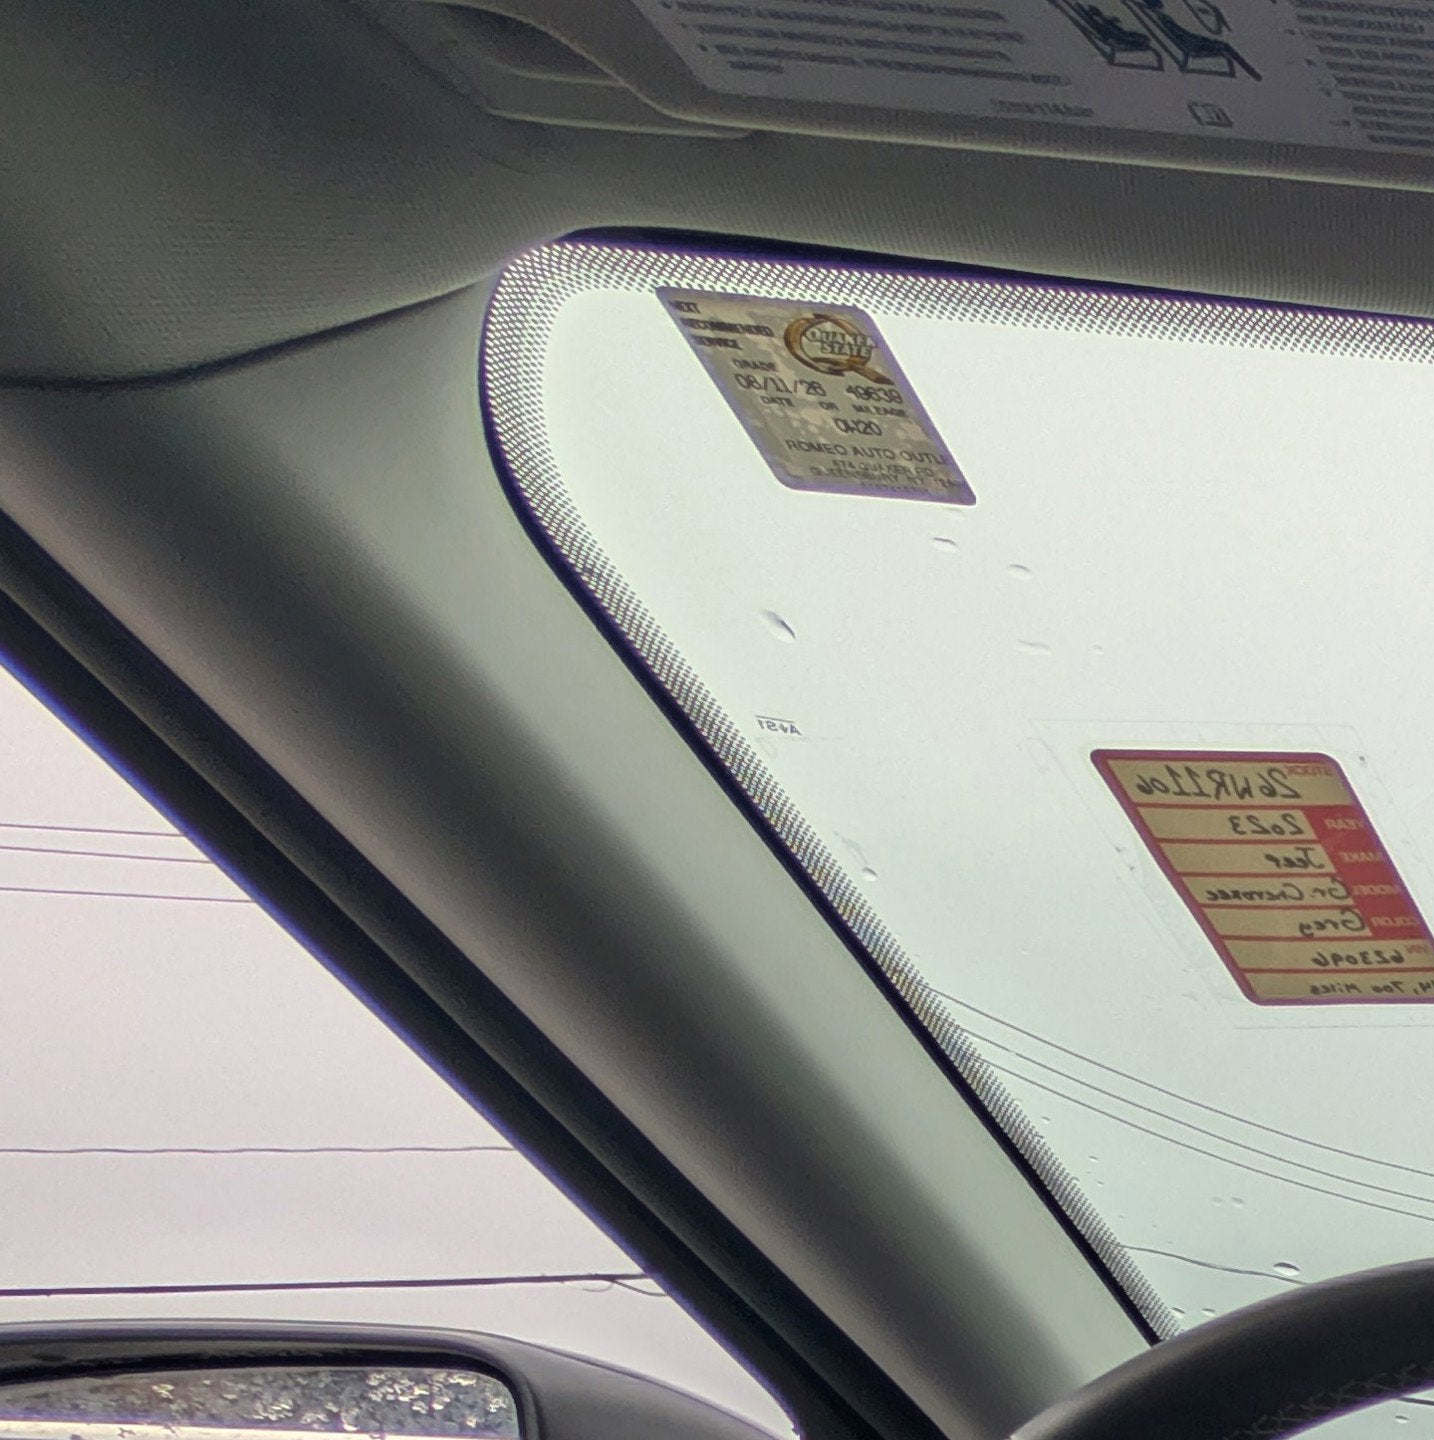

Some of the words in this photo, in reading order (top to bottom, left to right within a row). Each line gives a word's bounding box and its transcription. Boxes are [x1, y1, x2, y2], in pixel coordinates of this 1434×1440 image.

[820, 342, 871, 358] STATE
[761, 396, 794, 407] DATE
[785, 439, 848, 456] ROMEO
[852, 446, 896, 461] AUTO
